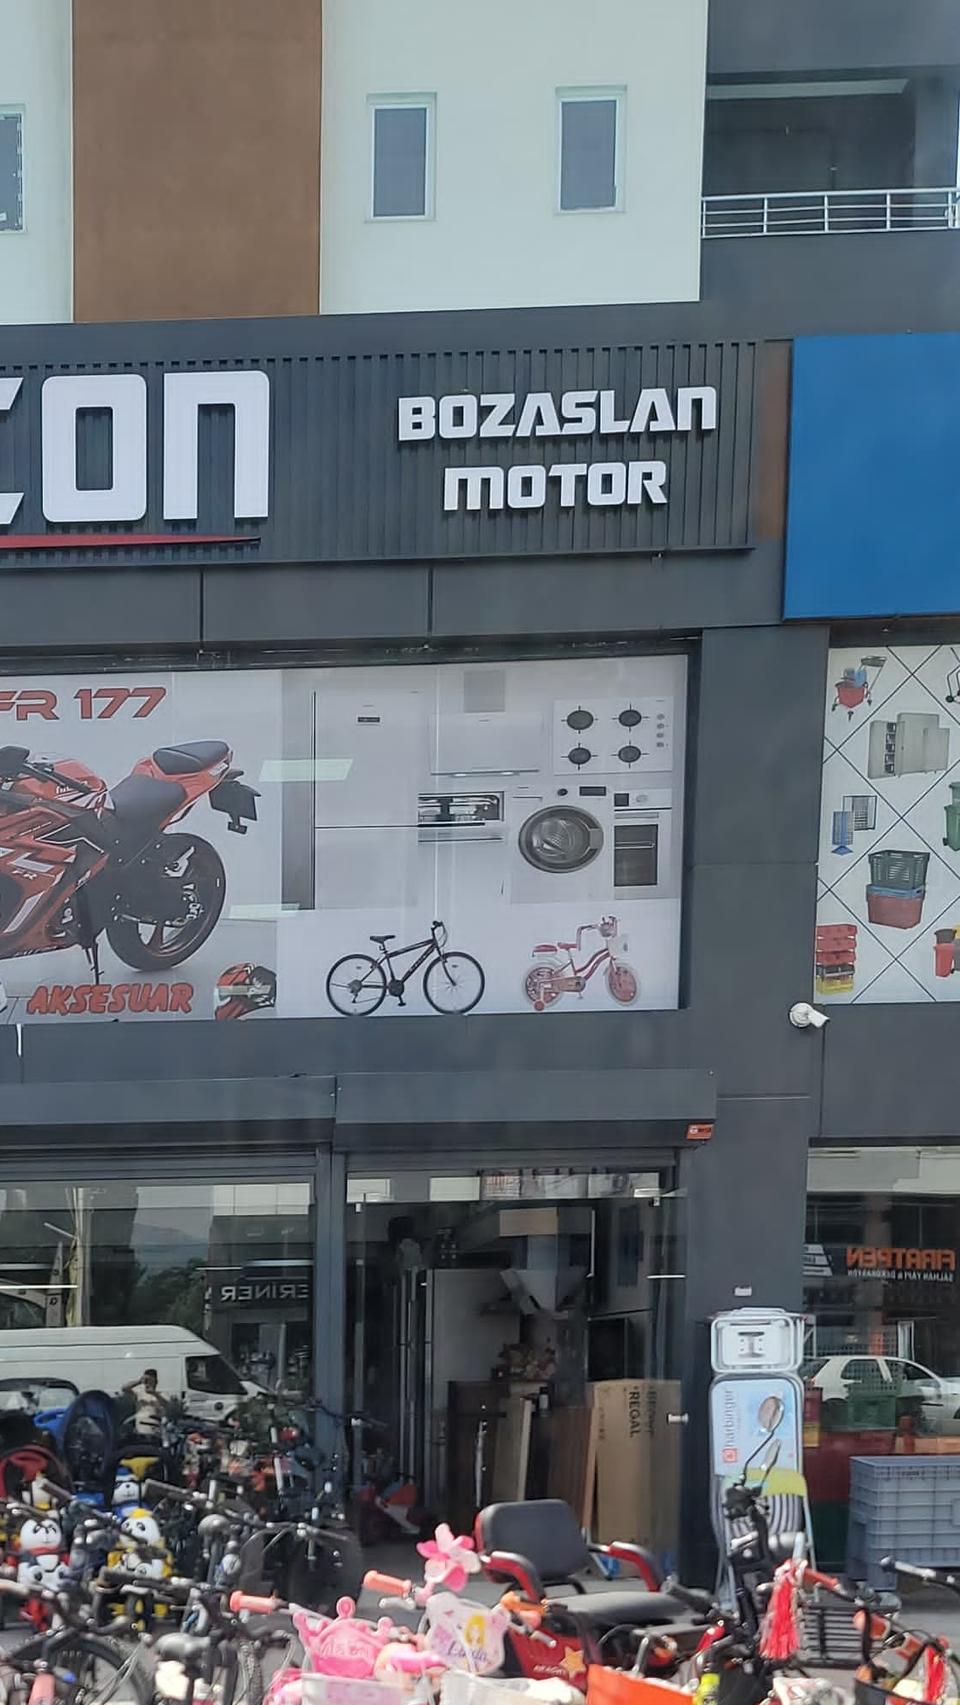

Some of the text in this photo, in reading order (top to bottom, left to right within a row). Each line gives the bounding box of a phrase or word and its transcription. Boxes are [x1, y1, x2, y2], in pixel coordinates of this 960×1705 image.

[398, 386, 717, 441] BOZASLAN
[443, 460, 668, 511] MOTOR
[73, 686, 167, 720] 177
[26, 982, 194, 1016] AKSESUAR
